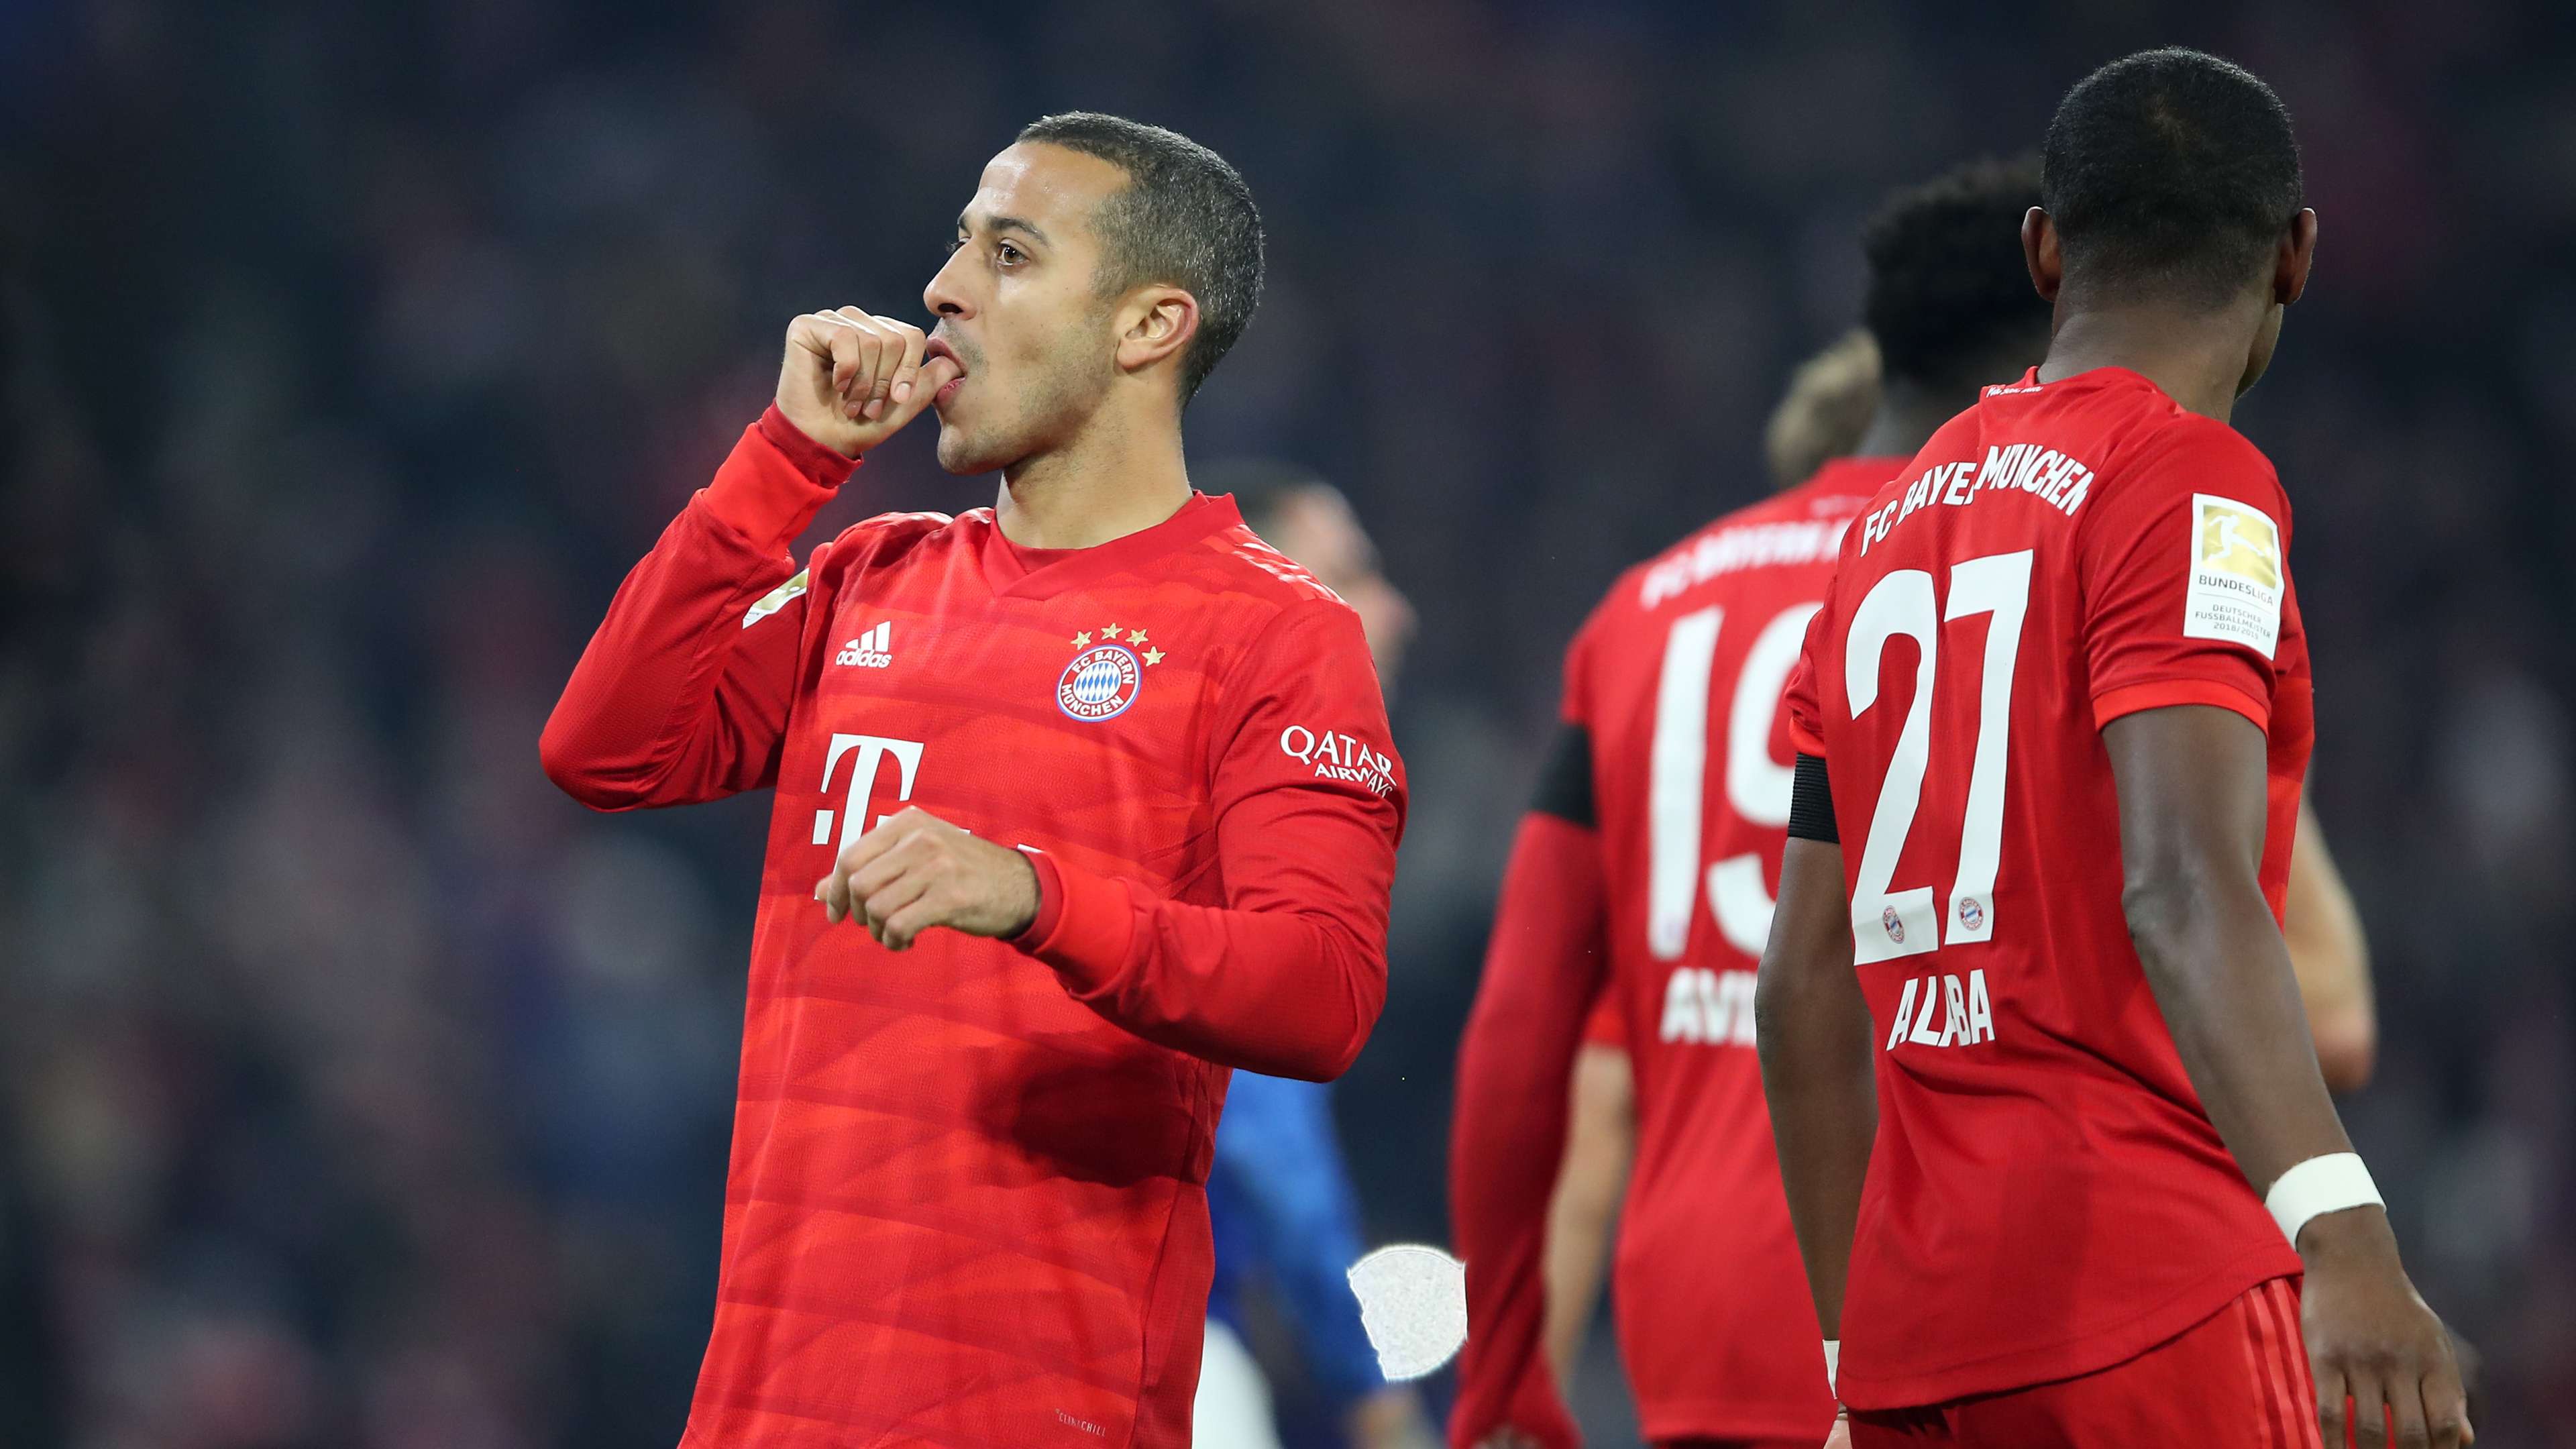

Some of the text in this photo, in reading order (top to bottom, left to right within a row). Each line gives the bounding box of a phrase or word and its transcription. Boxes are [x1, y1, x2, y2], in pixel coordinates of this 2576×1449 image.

[1860, 499, 1898, 558] FC
[1896, 462, 1978, 527] BAYE
[2199, 574, 2273, 606] BUNDESLIGA
[2195, 611, 2271, 638] FUSSBALLMEISTER
[2212, 604, 2261, 623] DEUTSCHER
[836, 648, 892, 668] adidas
[1071, 649, 1134, 684] FC BAYERN
[1281, 725, 1397, 787] QATAR
[1845, 548, 2034, 965] 27
[1315, 763, 1393, 798] AIRWAYS
[1647, 601, 1824, 961] 19
